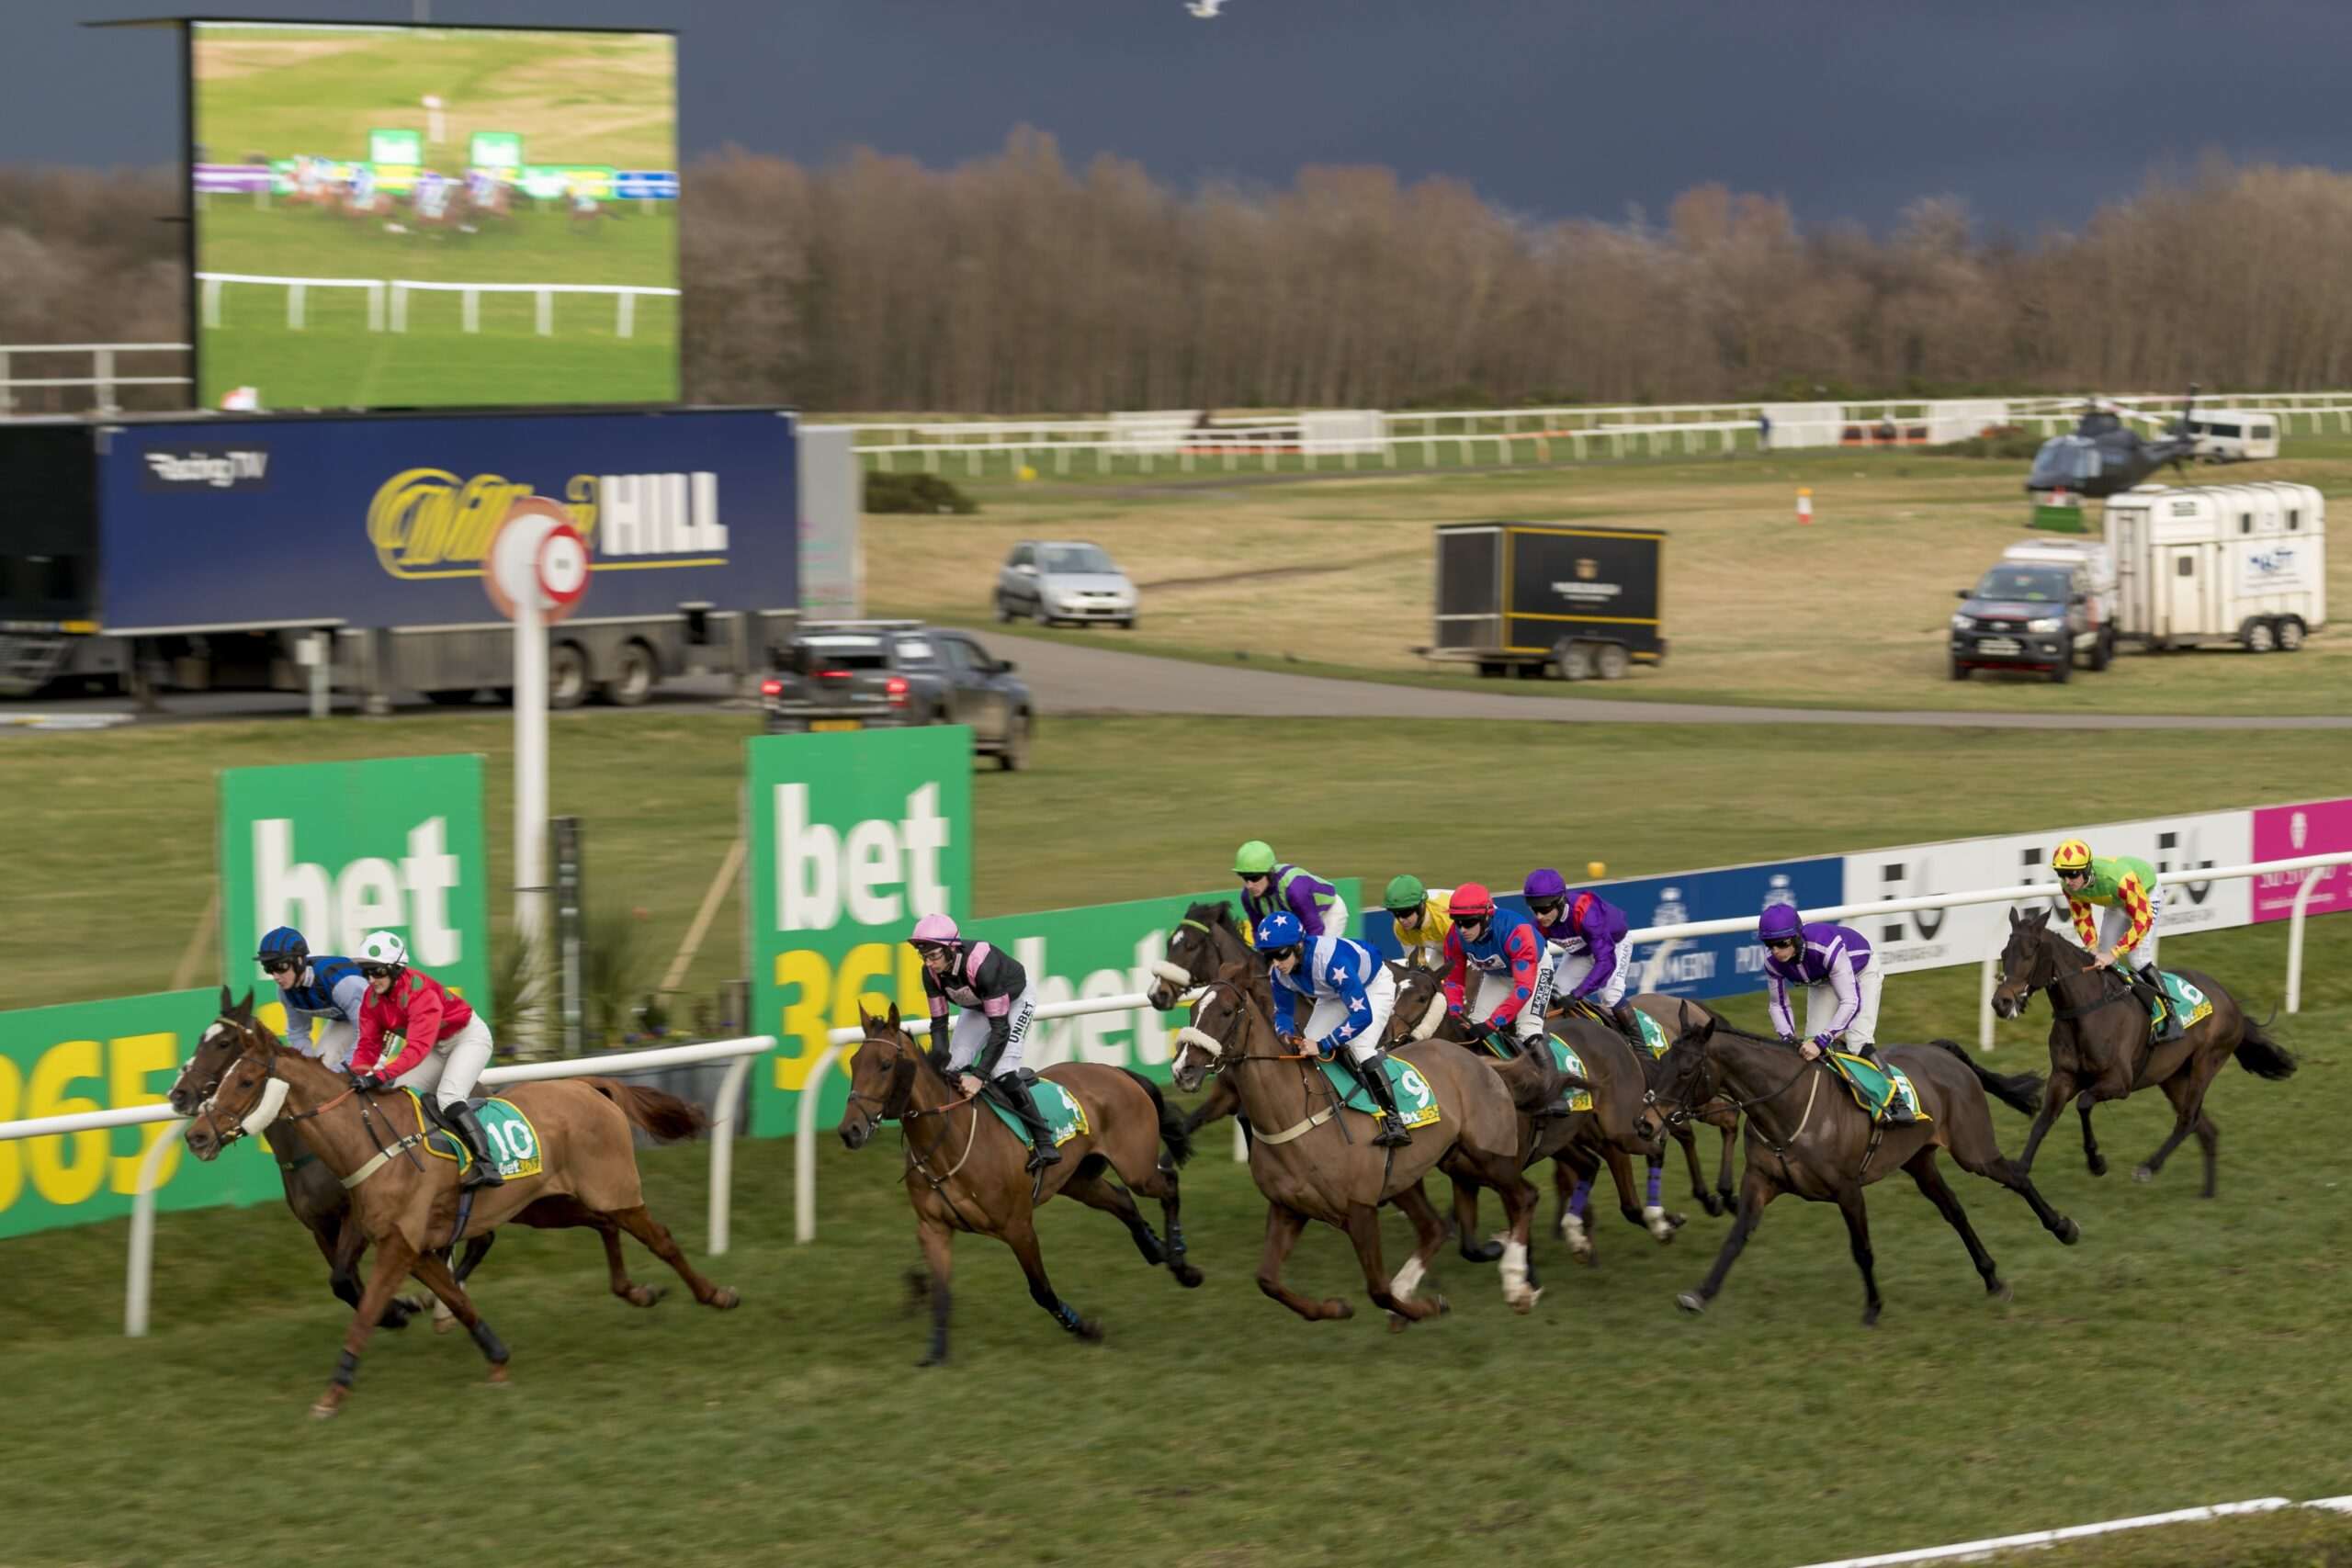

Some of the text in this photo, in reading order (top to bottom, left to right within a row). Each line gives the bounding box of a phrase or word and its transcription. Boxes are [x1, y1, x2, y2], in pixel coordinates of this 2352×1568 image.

[600, 471, 729, 556] HILL
[772, 781, 950, 931] bet
[251, 815, 459, 981] bet
[1008, 1001, 1034, 1043] UNIBET
[1013, 929, 1170, 1074] bet
[2177, 978, 2203, 1006] 6
[1401, 1070, 1430, 1109] 9
[486, 1119, 534, 1162] 10
